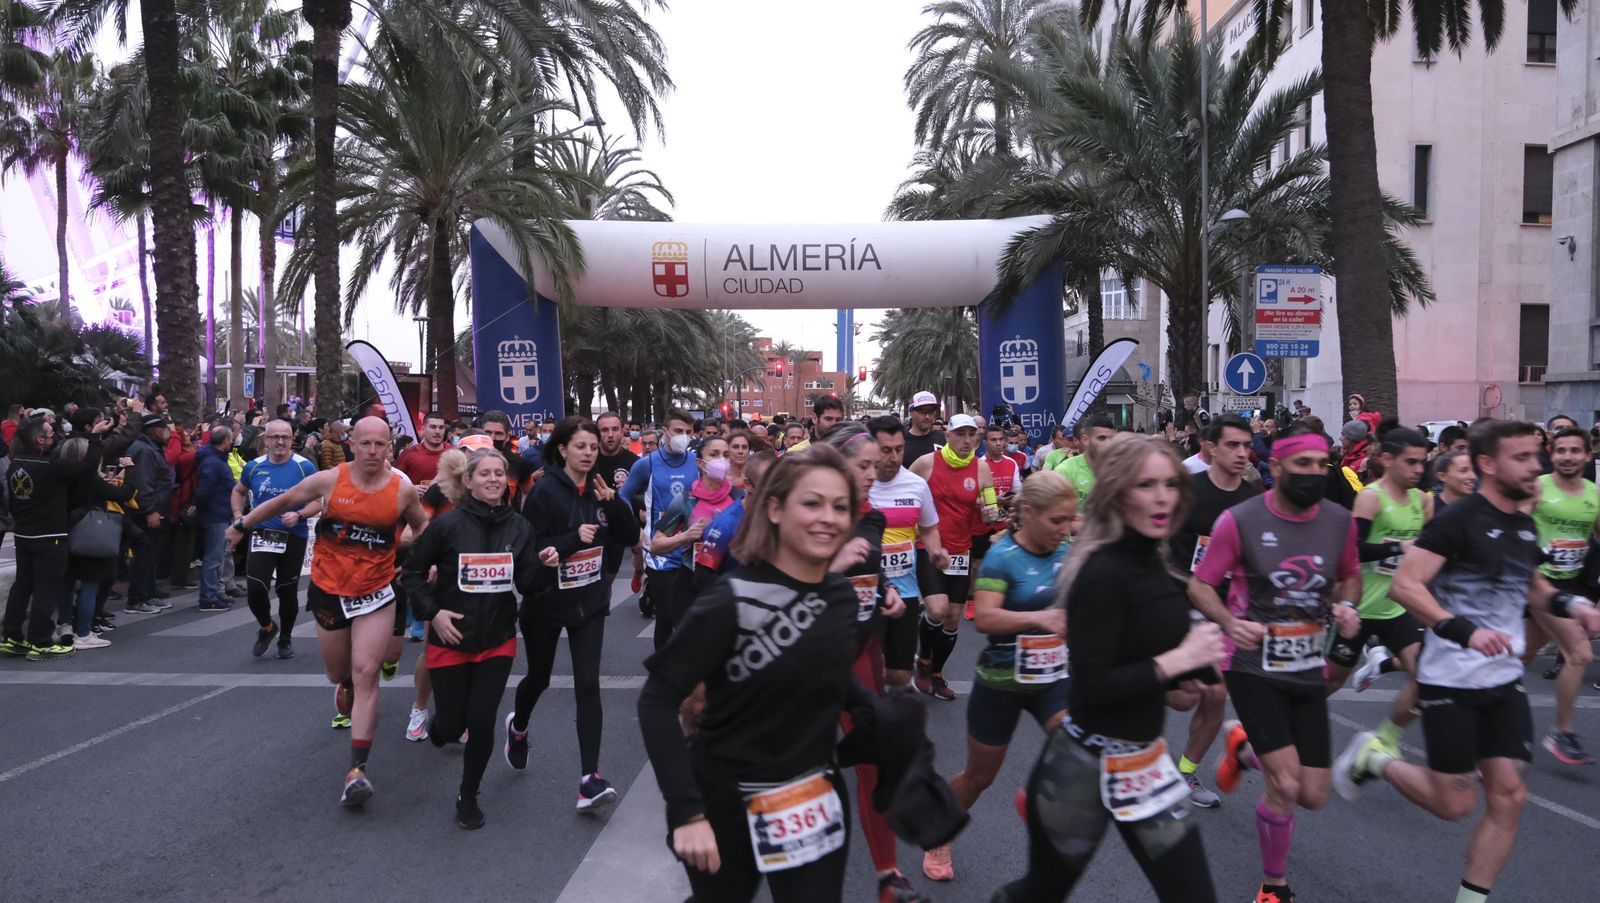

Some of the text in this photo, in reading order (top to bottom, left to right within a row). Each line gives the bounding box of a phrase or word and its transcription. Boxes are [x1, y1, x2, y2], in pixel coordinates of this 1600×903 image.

[722, 237, 882, 272] ALMERÍA
[723, 277, 804, 294] CIUDAD
[1260, 279, 1277, 298] P
[1297, 286, 1306, 294] 20
[988, 409, 1058, 428] AERÍA
[470, 566, 507, 579] 3304
[568, 560, 598, 575] 3226
[725, 591, 828, 682] adidas
[768, 802, 830, 839] 3361
